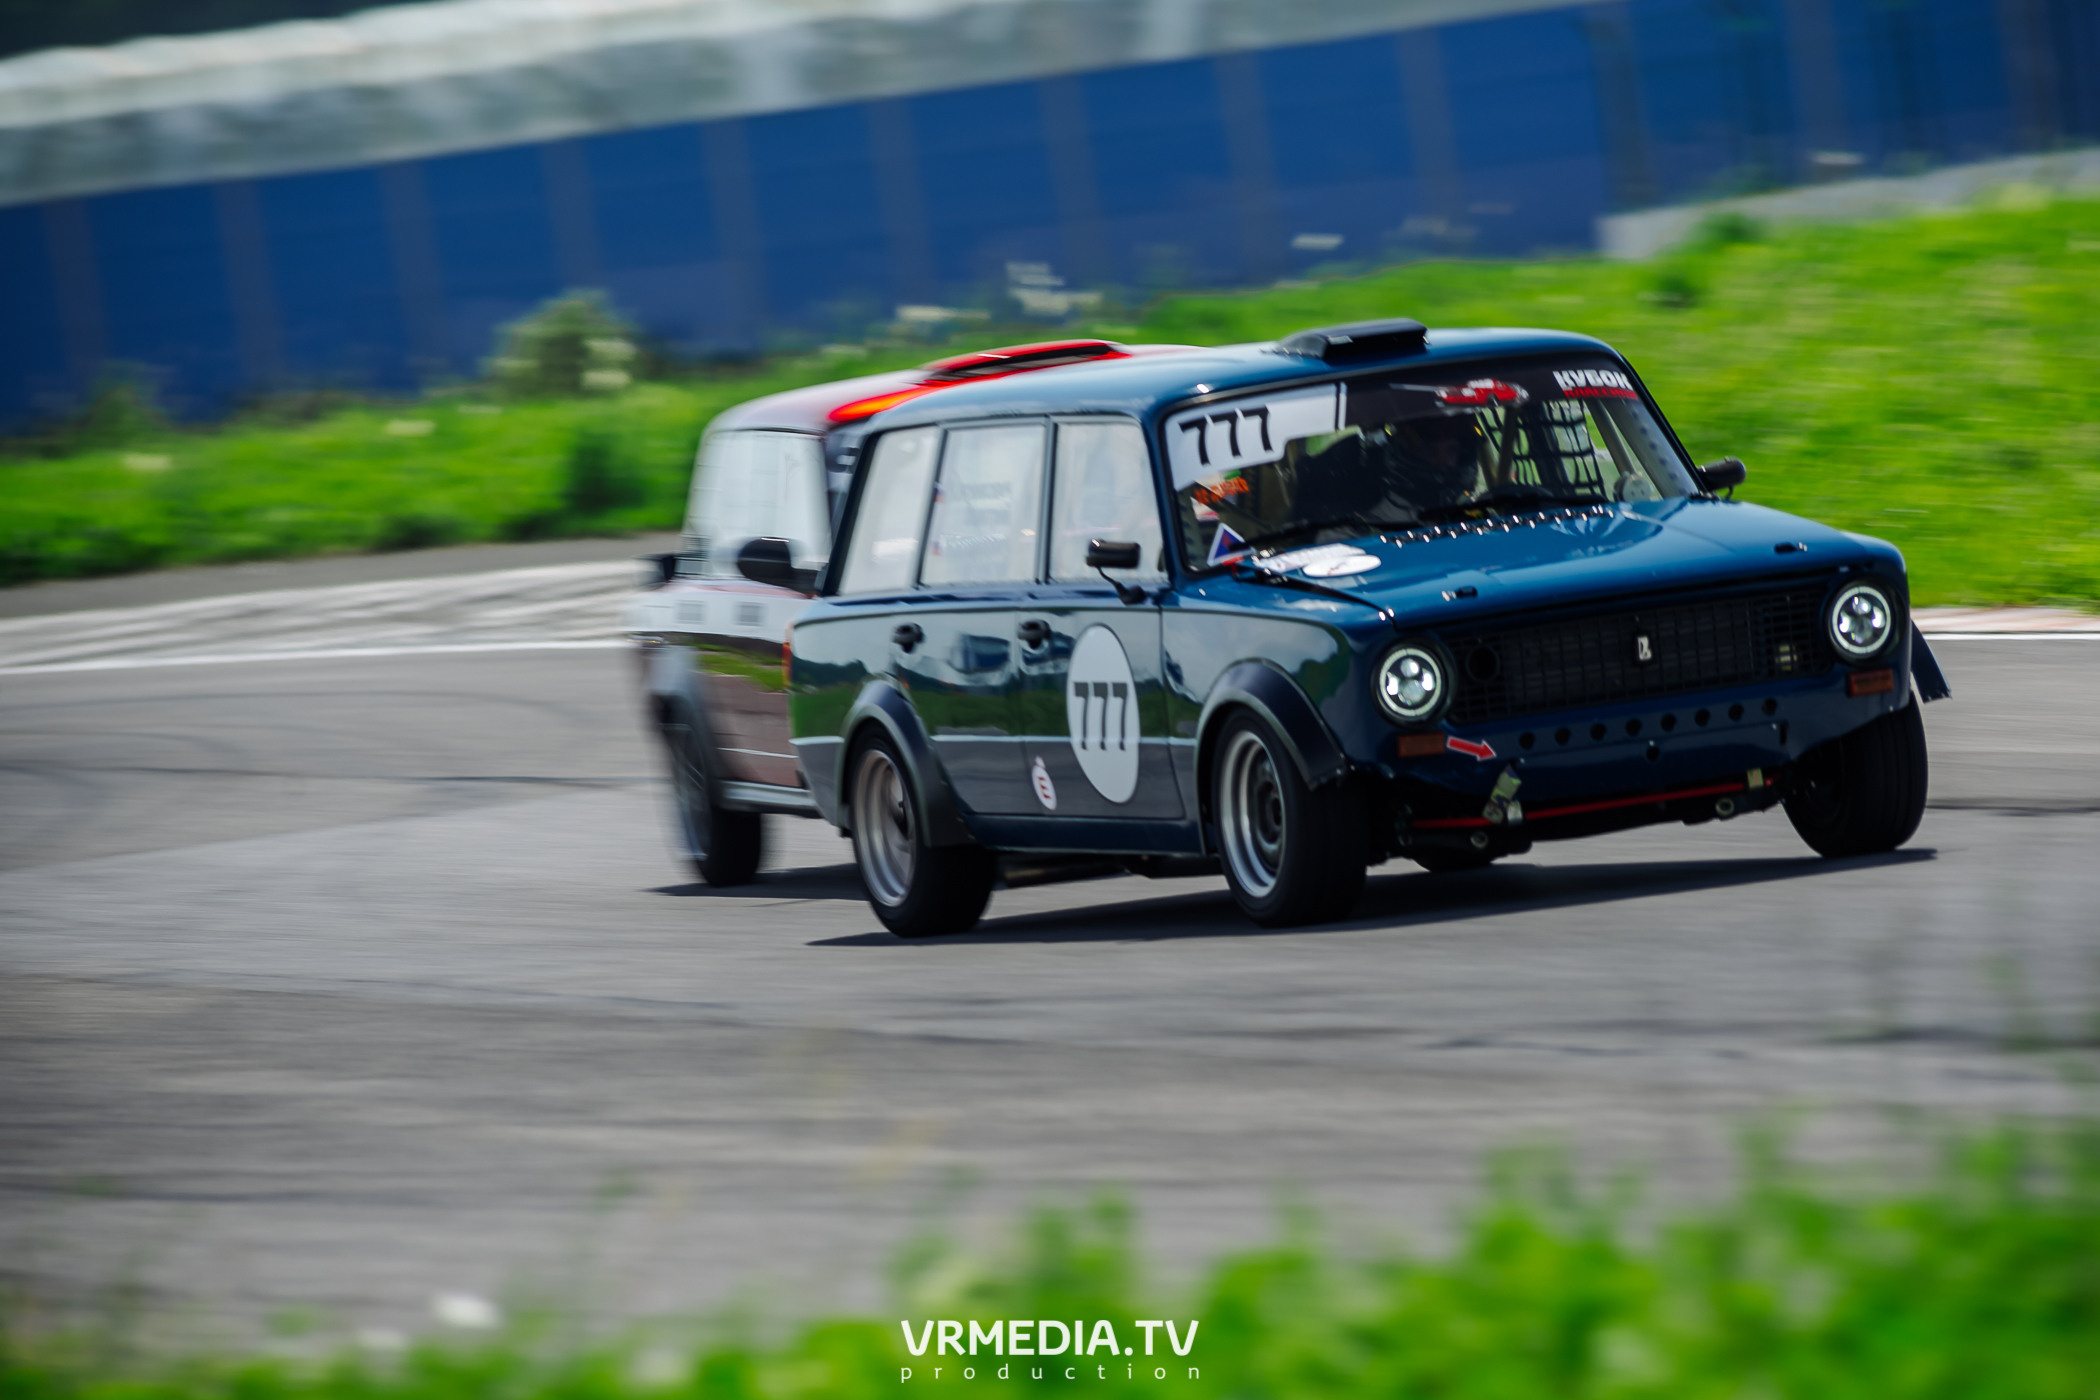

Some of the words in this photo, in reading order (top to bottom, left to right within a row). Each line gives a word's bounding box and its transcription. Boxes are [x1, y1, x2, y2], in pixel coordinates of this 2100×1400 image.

[1552, 369, 1634, 391] КУБОК
[1178, 405, 1274, 466] 777
[1073, 681, 1128, 751] 777
